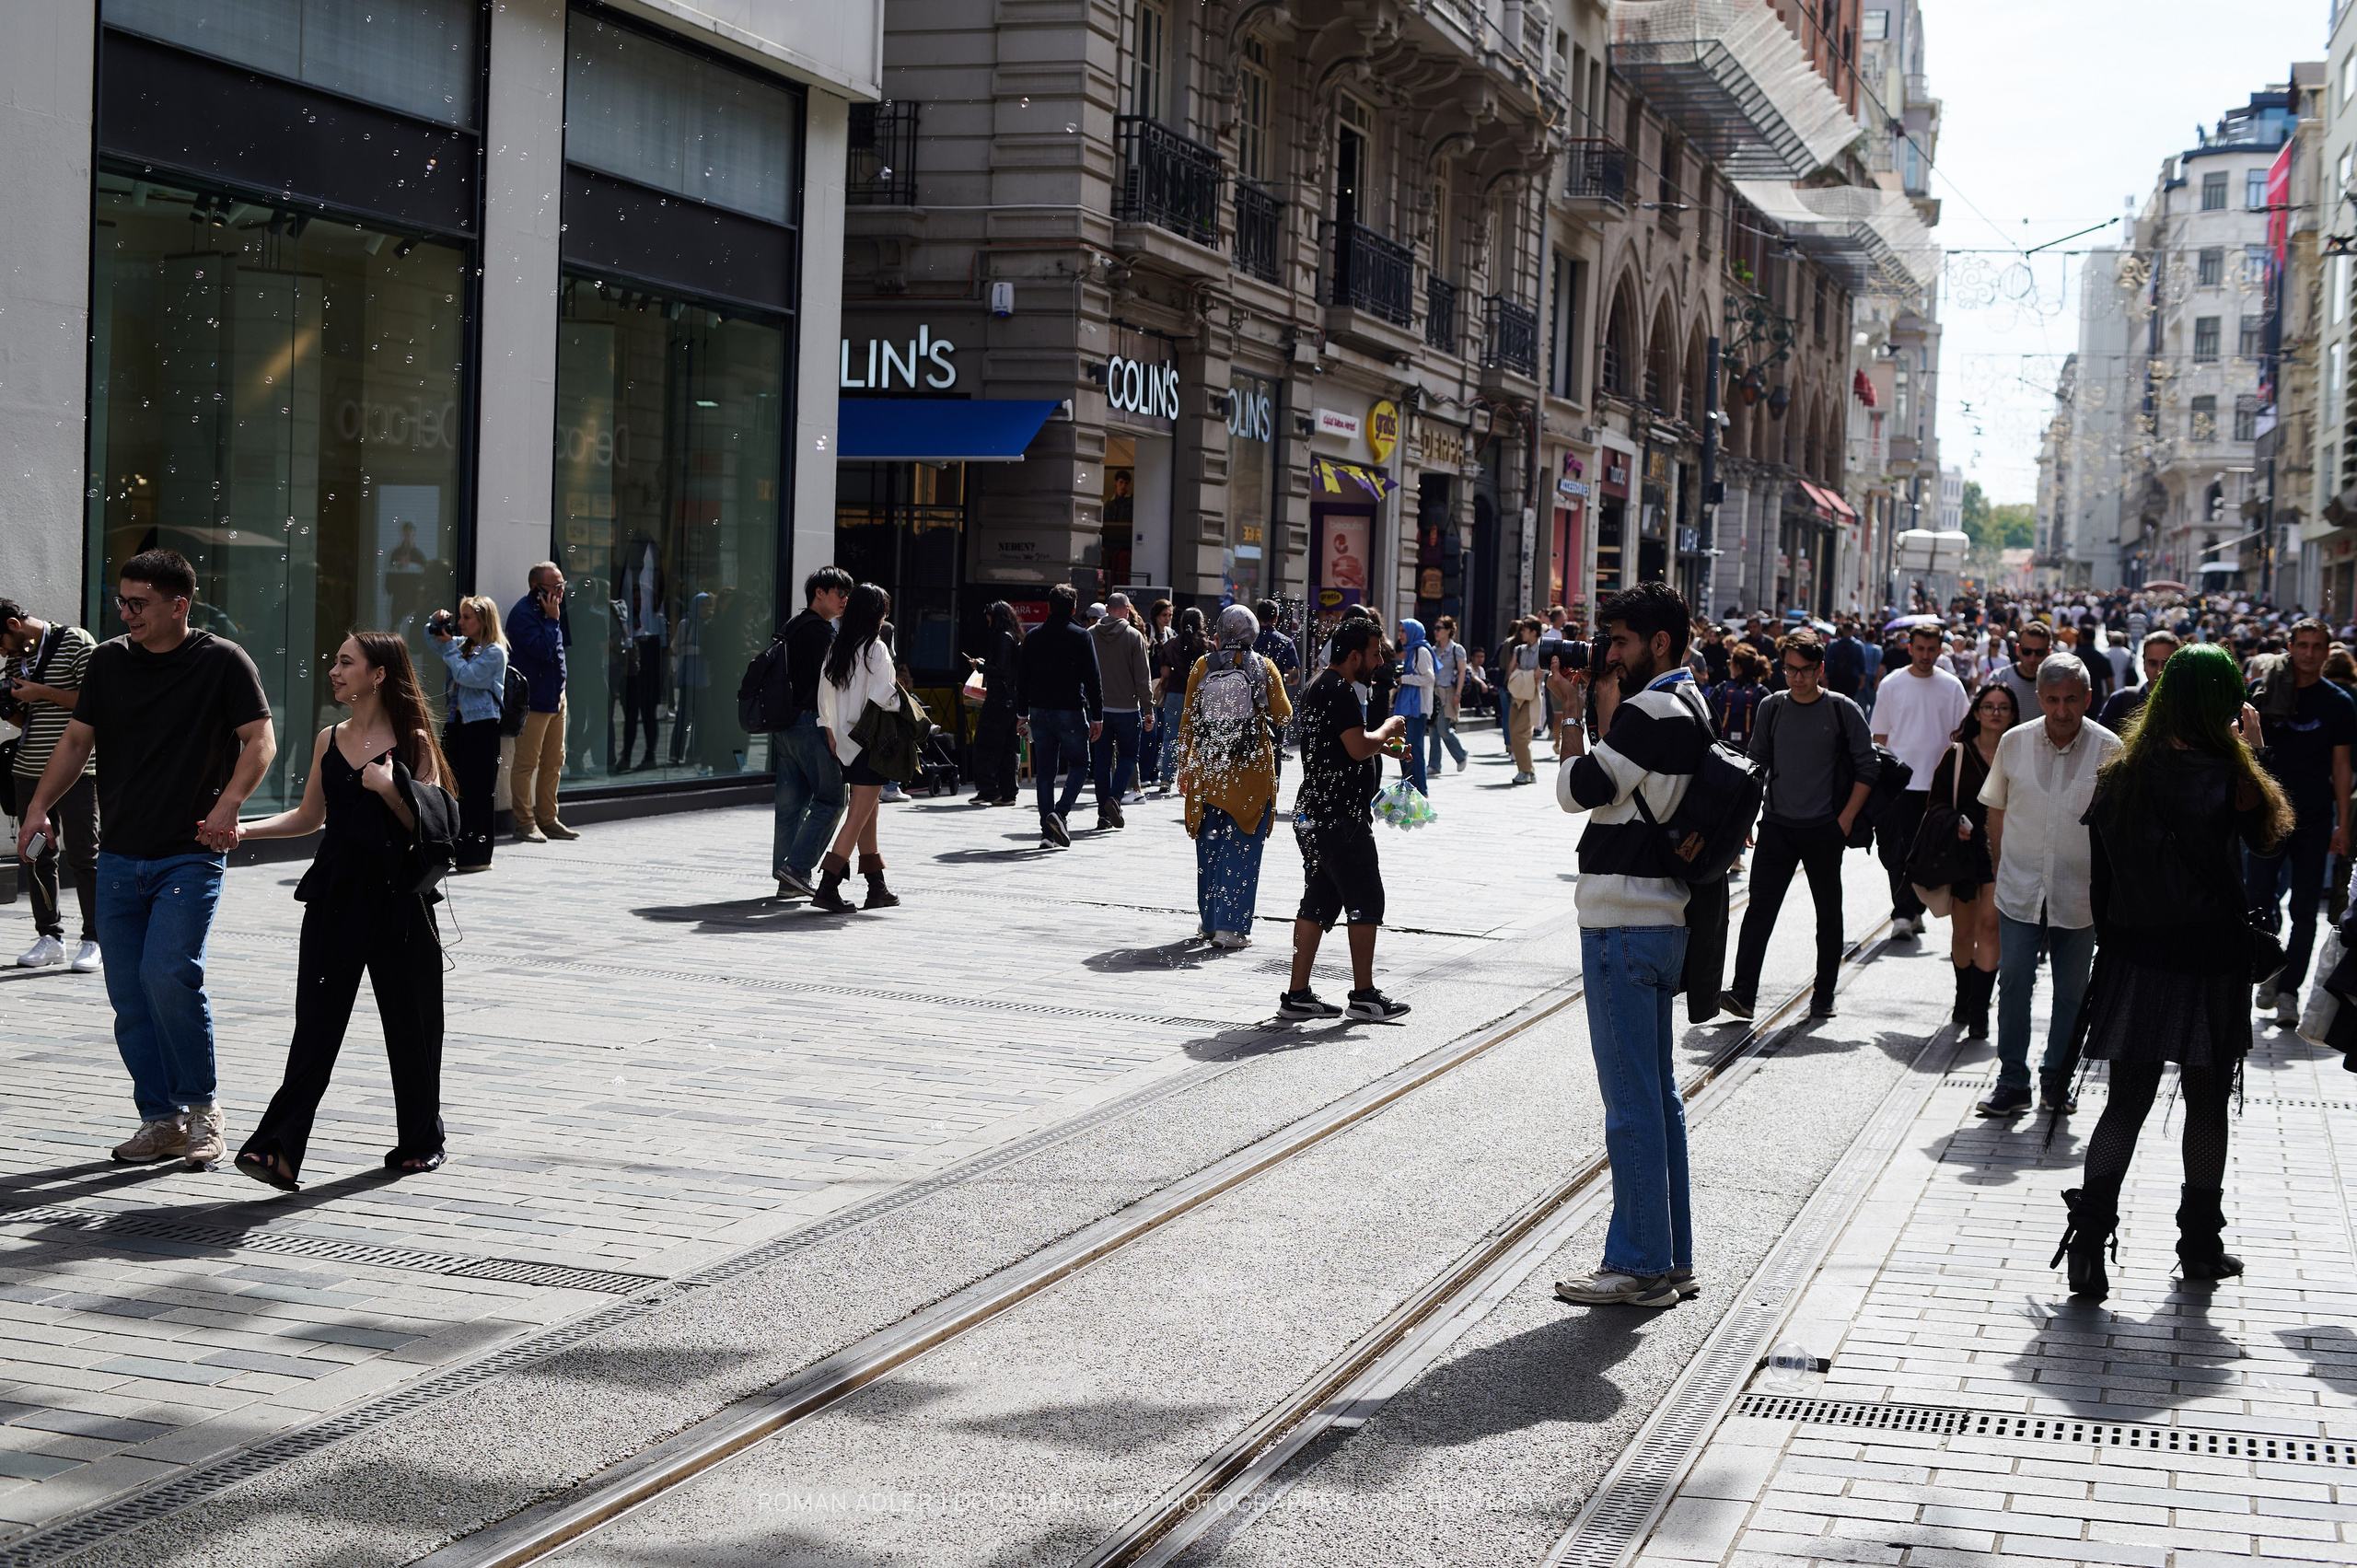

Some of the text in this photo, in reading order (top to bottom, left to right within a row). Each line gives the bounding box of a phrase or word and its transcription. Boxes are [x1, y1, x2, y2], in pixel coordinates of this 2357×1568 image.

[841, 324, 957, 389] LIN'S
[1108, 355, 1178, 421] COLIN'S
[1376, 410, 1396, 439] gratis
[1422, 427, 1464, 465] DERPA
[1560, 478, 1589, 497] ACCESSORIES
[998, 542, 1035, 552] NEDEN?
[1319, 593, 1341, 601] gratis
